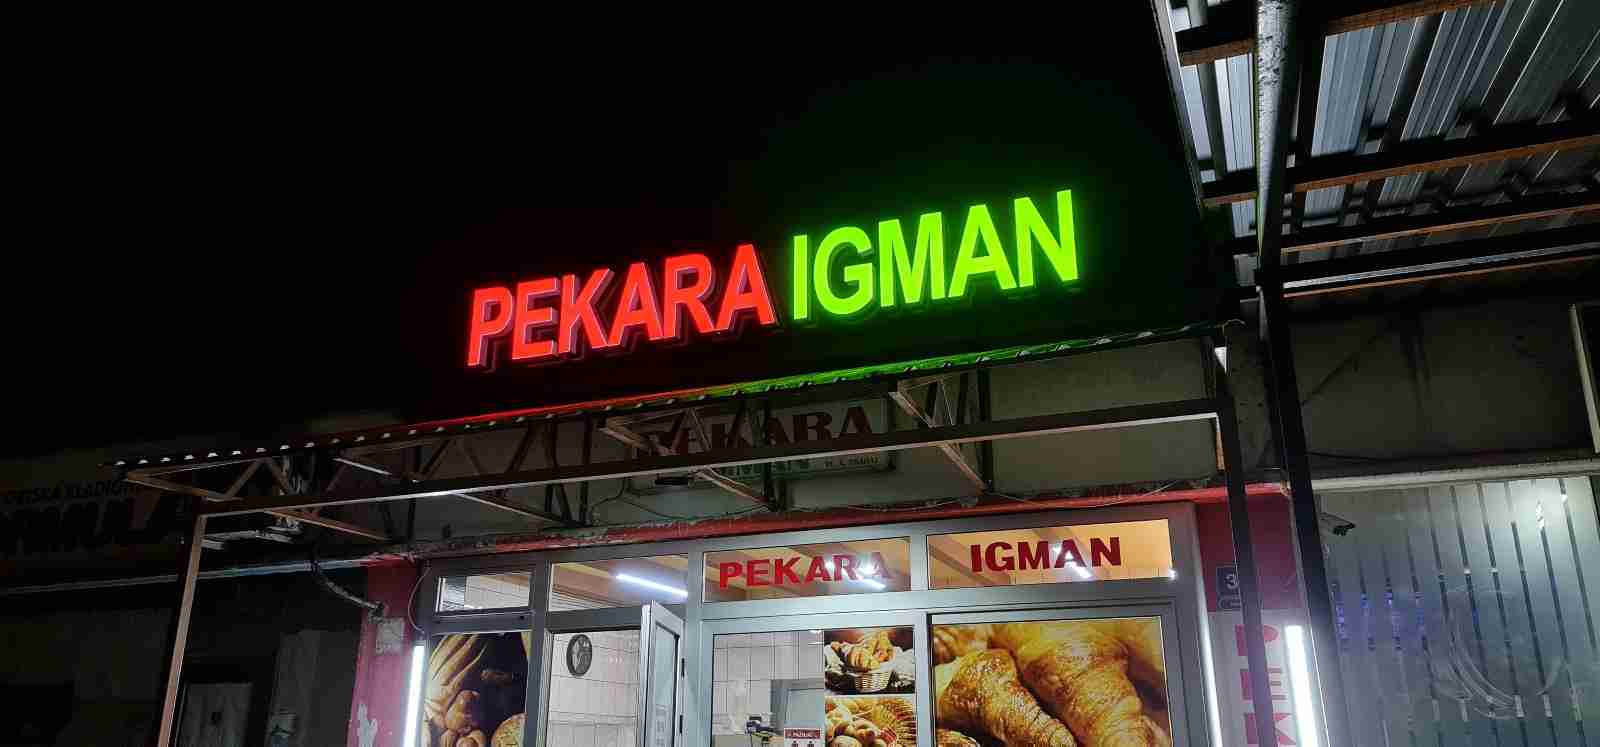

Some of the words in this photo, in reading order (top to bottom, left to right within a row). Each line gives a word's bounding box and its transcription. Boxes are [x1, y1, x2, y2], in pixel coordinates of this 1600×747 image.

[467, 243, 778, 367] PEKARA
[792, 188, 1079, 321] IGMAN
[638, 404, 876, 458] EKARA
[719, 551, 895, 588] PEKARA
[970, 536, 1121, 572] IGMAN
